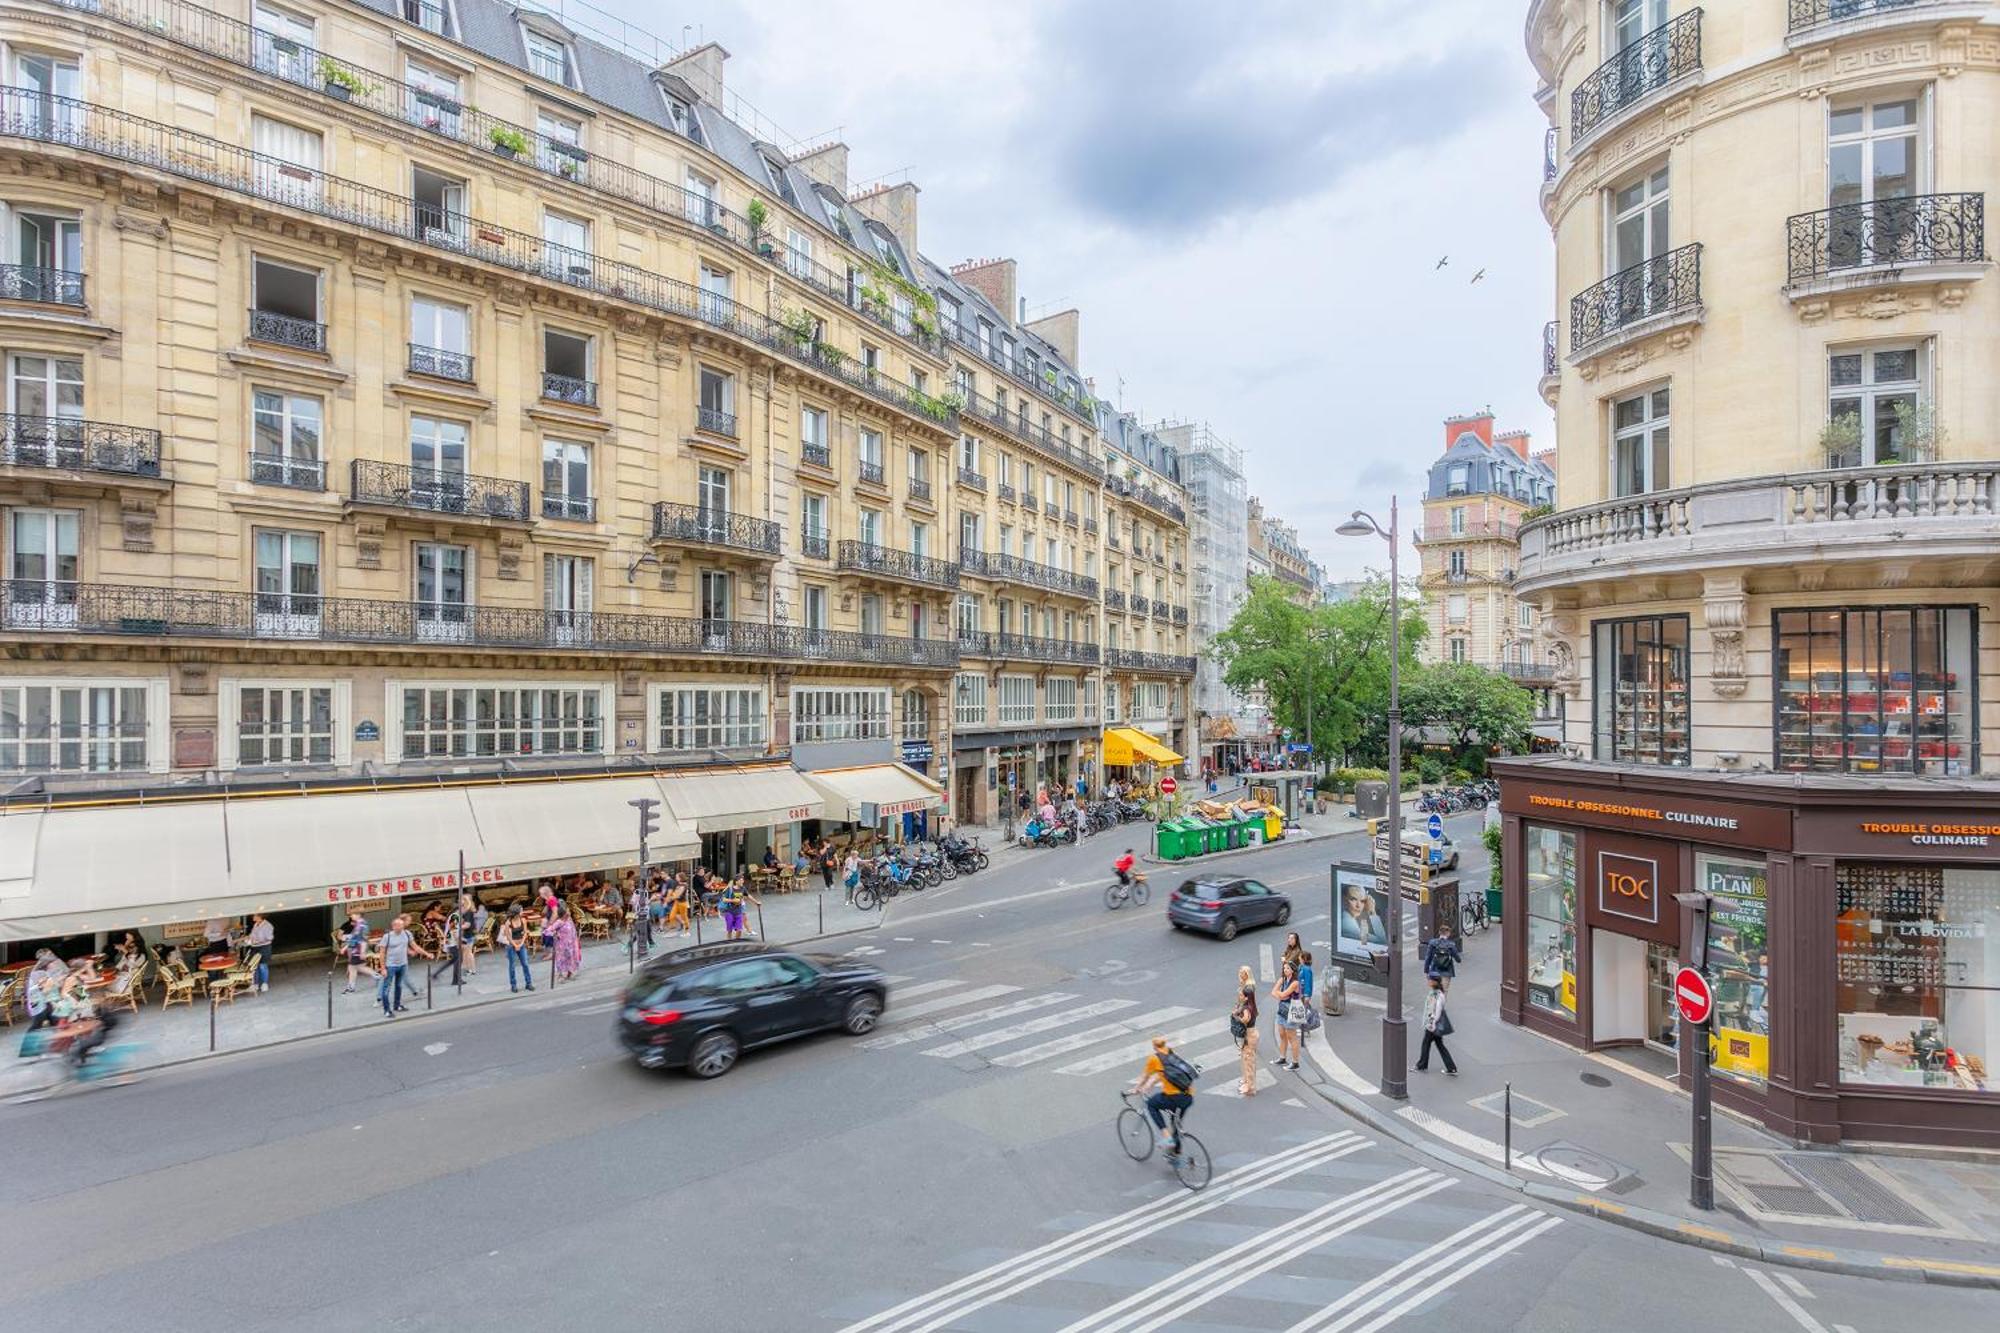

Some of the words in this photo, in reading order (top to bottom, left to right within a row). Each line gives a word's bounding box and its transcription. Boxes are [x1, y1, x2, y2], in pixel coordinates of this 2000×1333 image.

[1529, 795, 1575, 809] TROUBLE
[1576, 801, 1663, 820] OBSESSIONNEL
[1665, 811, 1738, 829] CULINAIRE
[1862, 823, 1927, 833] TROUBLE
[1931, 824, 2000, 835] OBSESSIO
[1911, 835, 1988, 846] CULINAIRE
[328, 878, 422, 901] ETIENNE
[1607, 872, 1649, 900] TOC
[1711, 872, 1752, 895] PLAN
[1900, 927, 1918, 936] LA
